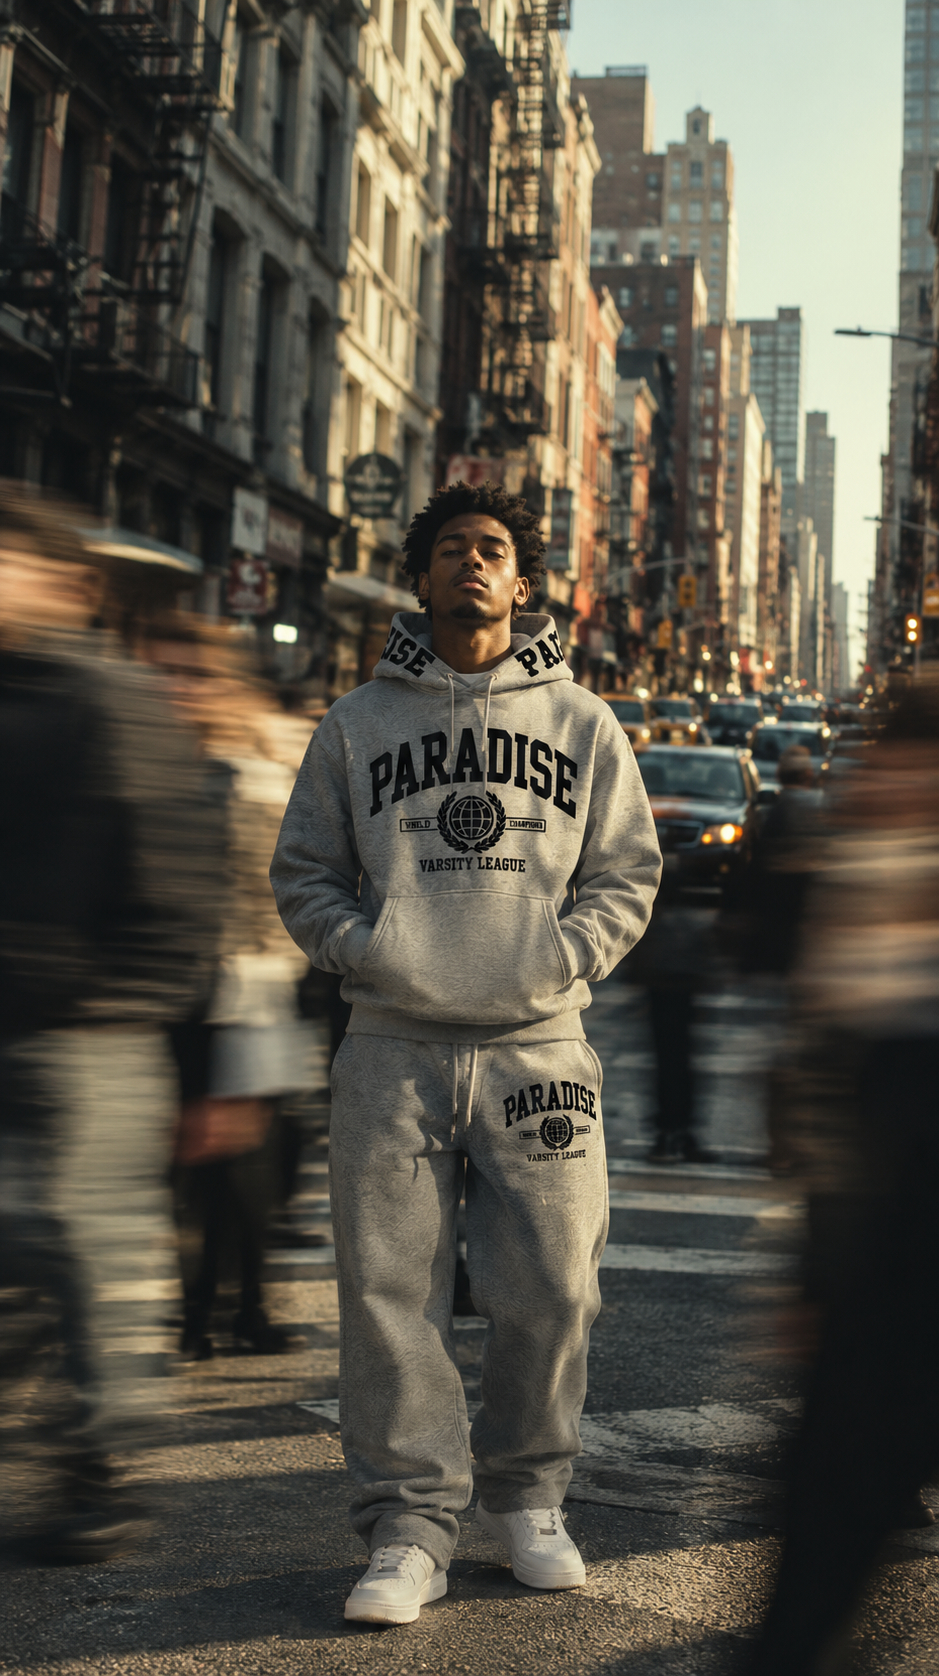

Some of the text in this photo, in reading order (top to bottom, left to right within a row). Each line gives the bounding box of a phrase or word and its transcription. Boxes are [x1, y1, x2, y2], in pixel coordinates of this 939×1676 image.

[370, 728, 577, 819] PARADISE
[419, 856, 526, 873] VARSITY LEAGUE
[503, 1081, 597, 1129] PARADISE
